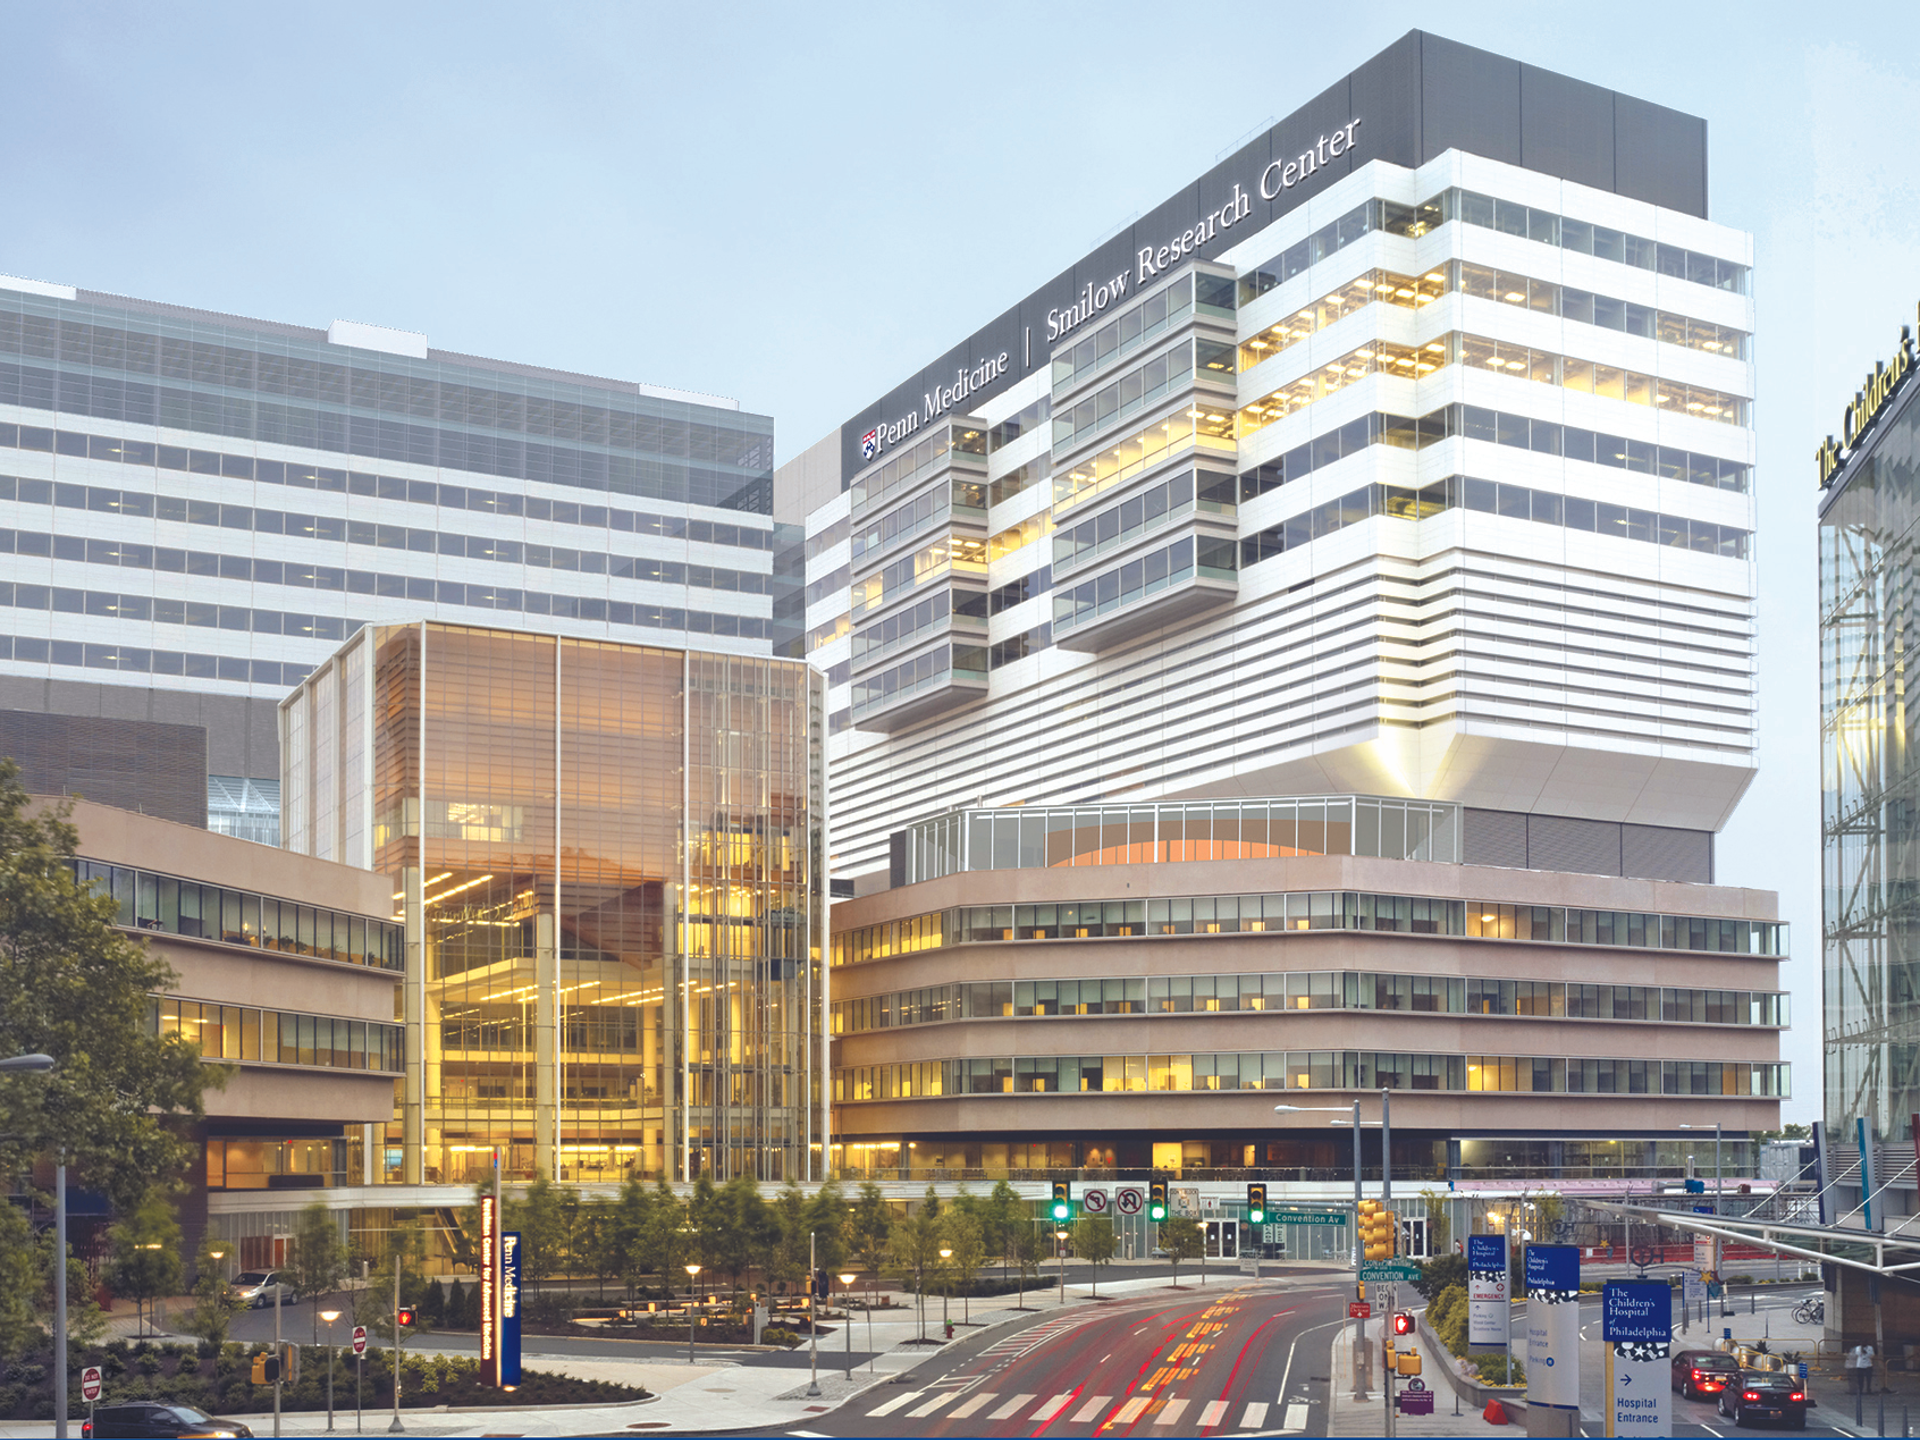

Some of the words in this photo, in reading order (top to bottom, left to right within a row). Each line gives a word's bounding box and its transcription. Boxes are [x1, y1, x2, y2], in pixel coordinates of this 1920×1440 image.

[876, 410, 920, 454] Penn
[923, 351, 1008, 424] Medicine
[1047, 269, 1132, 343] Smilow
[1137, 183, 1252, 285] Research
[1260, 118, 1362, 200] Center
[1815, 434, 1843, 489] The
[1843, 325, 1913, 450] Children's
[1276, 1213, 1326, 1224] Convention
[1328, 1216, 1340, 1225] Av
[483, 1237, 492, 1265] Center
[504, 1236, 517, 1264] Penn
[483, 1267, 492, 1280] for
[1362, 1271, 1404, 1281] CONVENTION
[1408, 1273, 1420, 1281] AVE
[503, 1266, 519, 1318] Medicine
[1609, 1287, 1629, 1297] The
[483, 1281, 492, 1321] Advanced
[1609, 1297, 1656, 1307] Children's
[1609, 1306, 1649, 1319] Hospital
[1529, 1328, 1548, 1337] Hospital
[1609, 1326, 1667, 1339] Philadelphia
[483, 1322, 492, 1360] Medicine
[1529, 1338, 1549, 1348] Entrance
[1529, 1355, 1546, 1366] Parking
[1617, 1397, 1657, 1410] Hospital
[1617, 1411, 1659, 1424] Entrance
